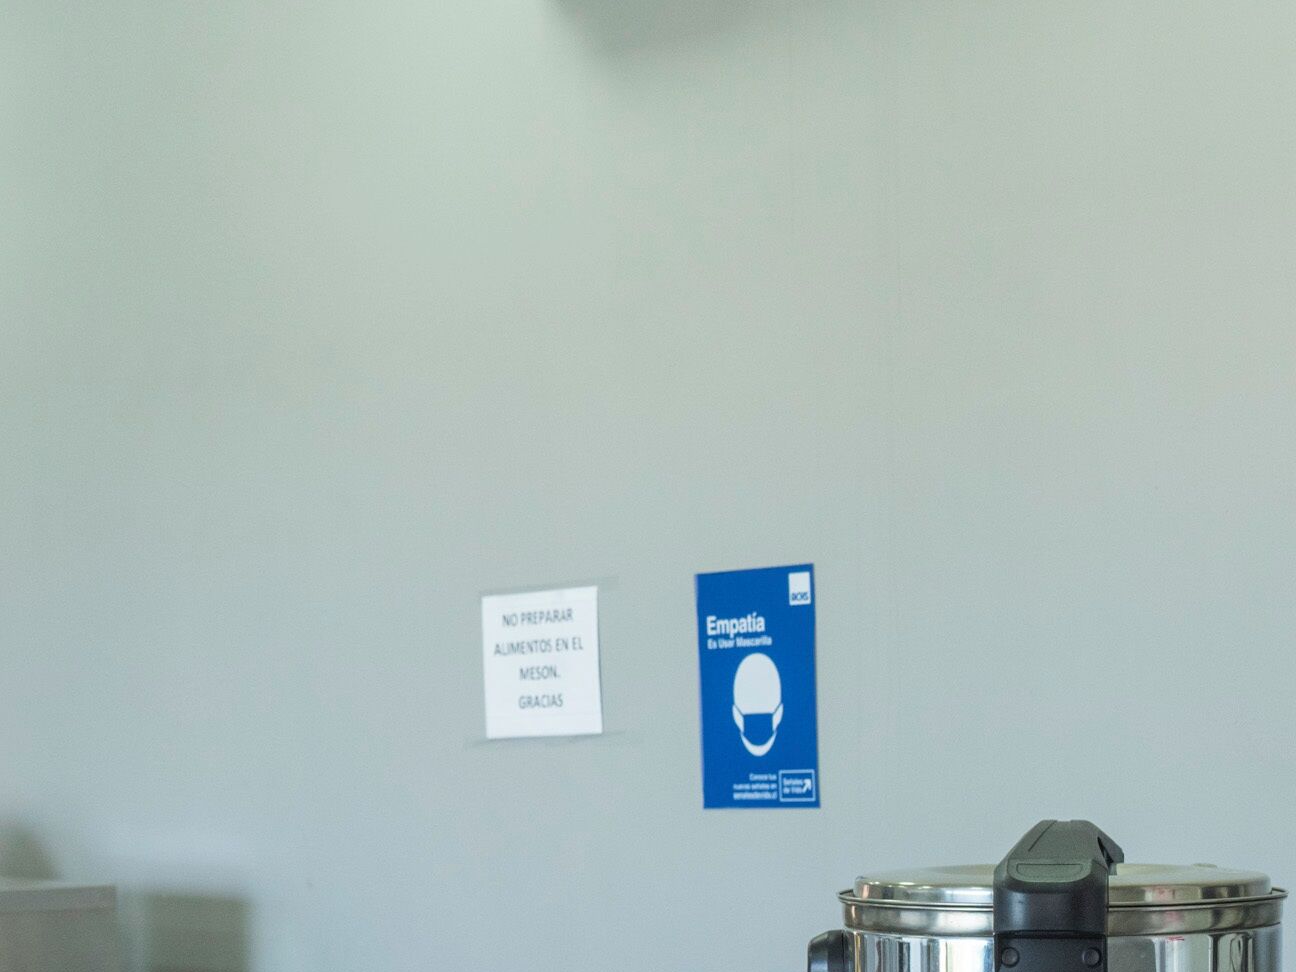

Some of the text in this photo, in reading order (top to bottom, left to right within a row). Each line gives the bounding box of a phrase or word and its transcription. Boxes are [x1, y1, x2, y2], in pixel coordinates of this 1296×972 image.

[502, 608, 573, 627] NO PREPARAR
[706, 611, 766, 639] Empatía
[494, 636, 584, 656] ALIMENTOS EN EL
[519, 665, 561, 680] MESON.
[518, 693, 564, 709] GRACIAS
